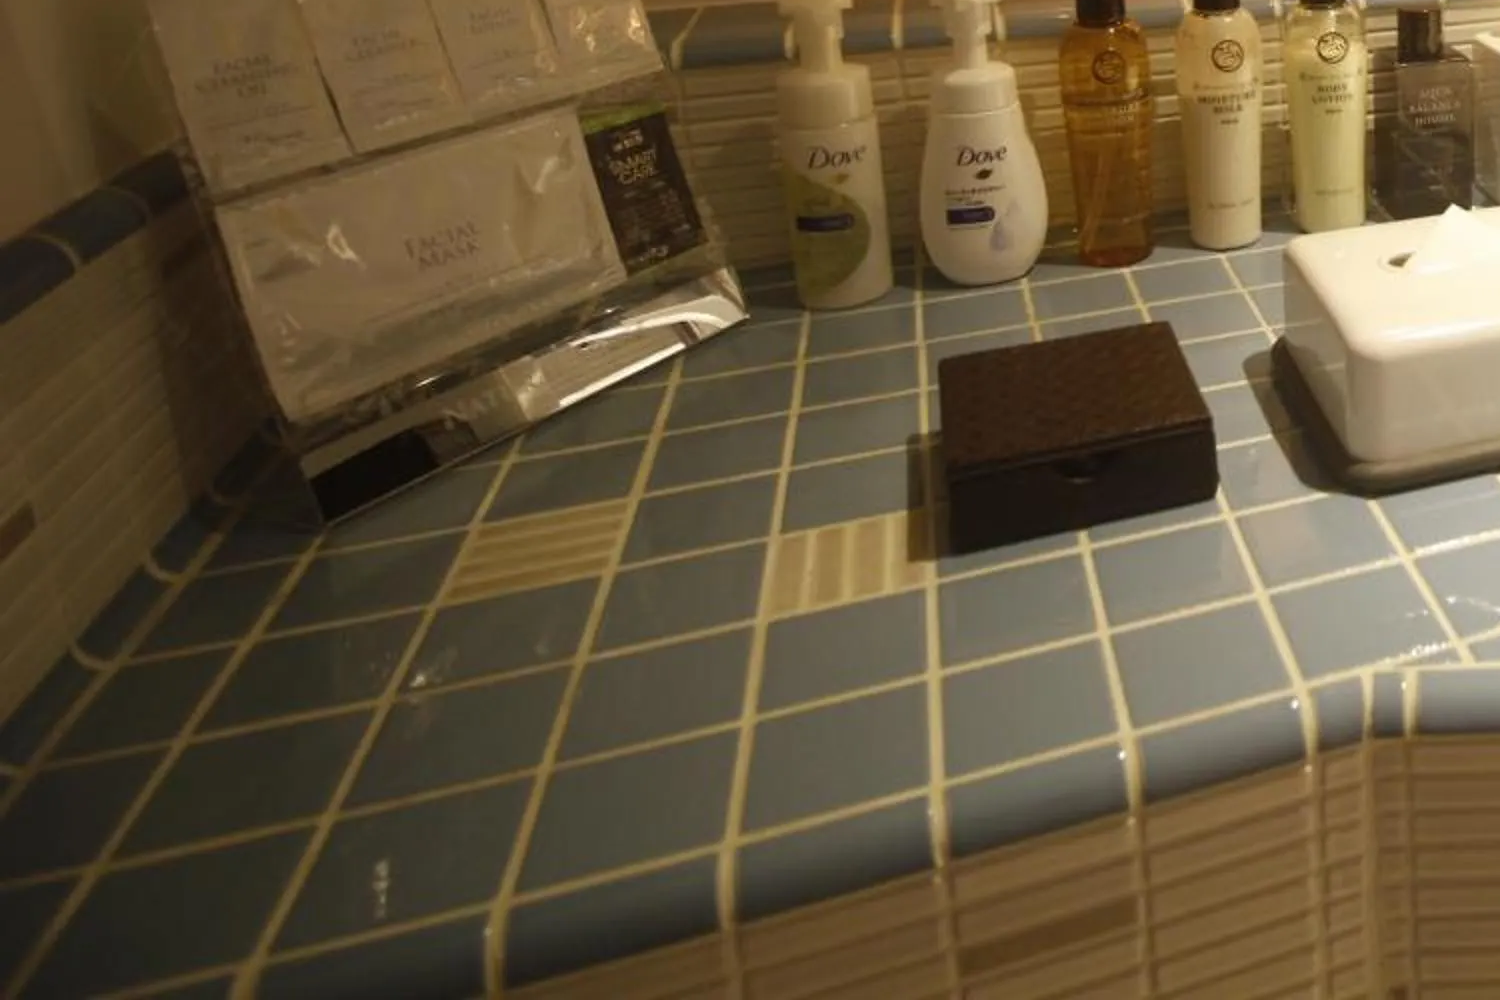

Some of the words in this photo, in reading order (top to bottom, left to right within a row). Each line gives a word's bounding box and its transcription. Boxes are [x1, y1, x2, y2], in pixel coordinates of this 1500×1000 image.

[806, 144, 867, 170] Dove
[956, 145, 1007, 167] Dove
[403, 220, 480, 260] FACIAL
[418, 237, 480, 272] MASK
